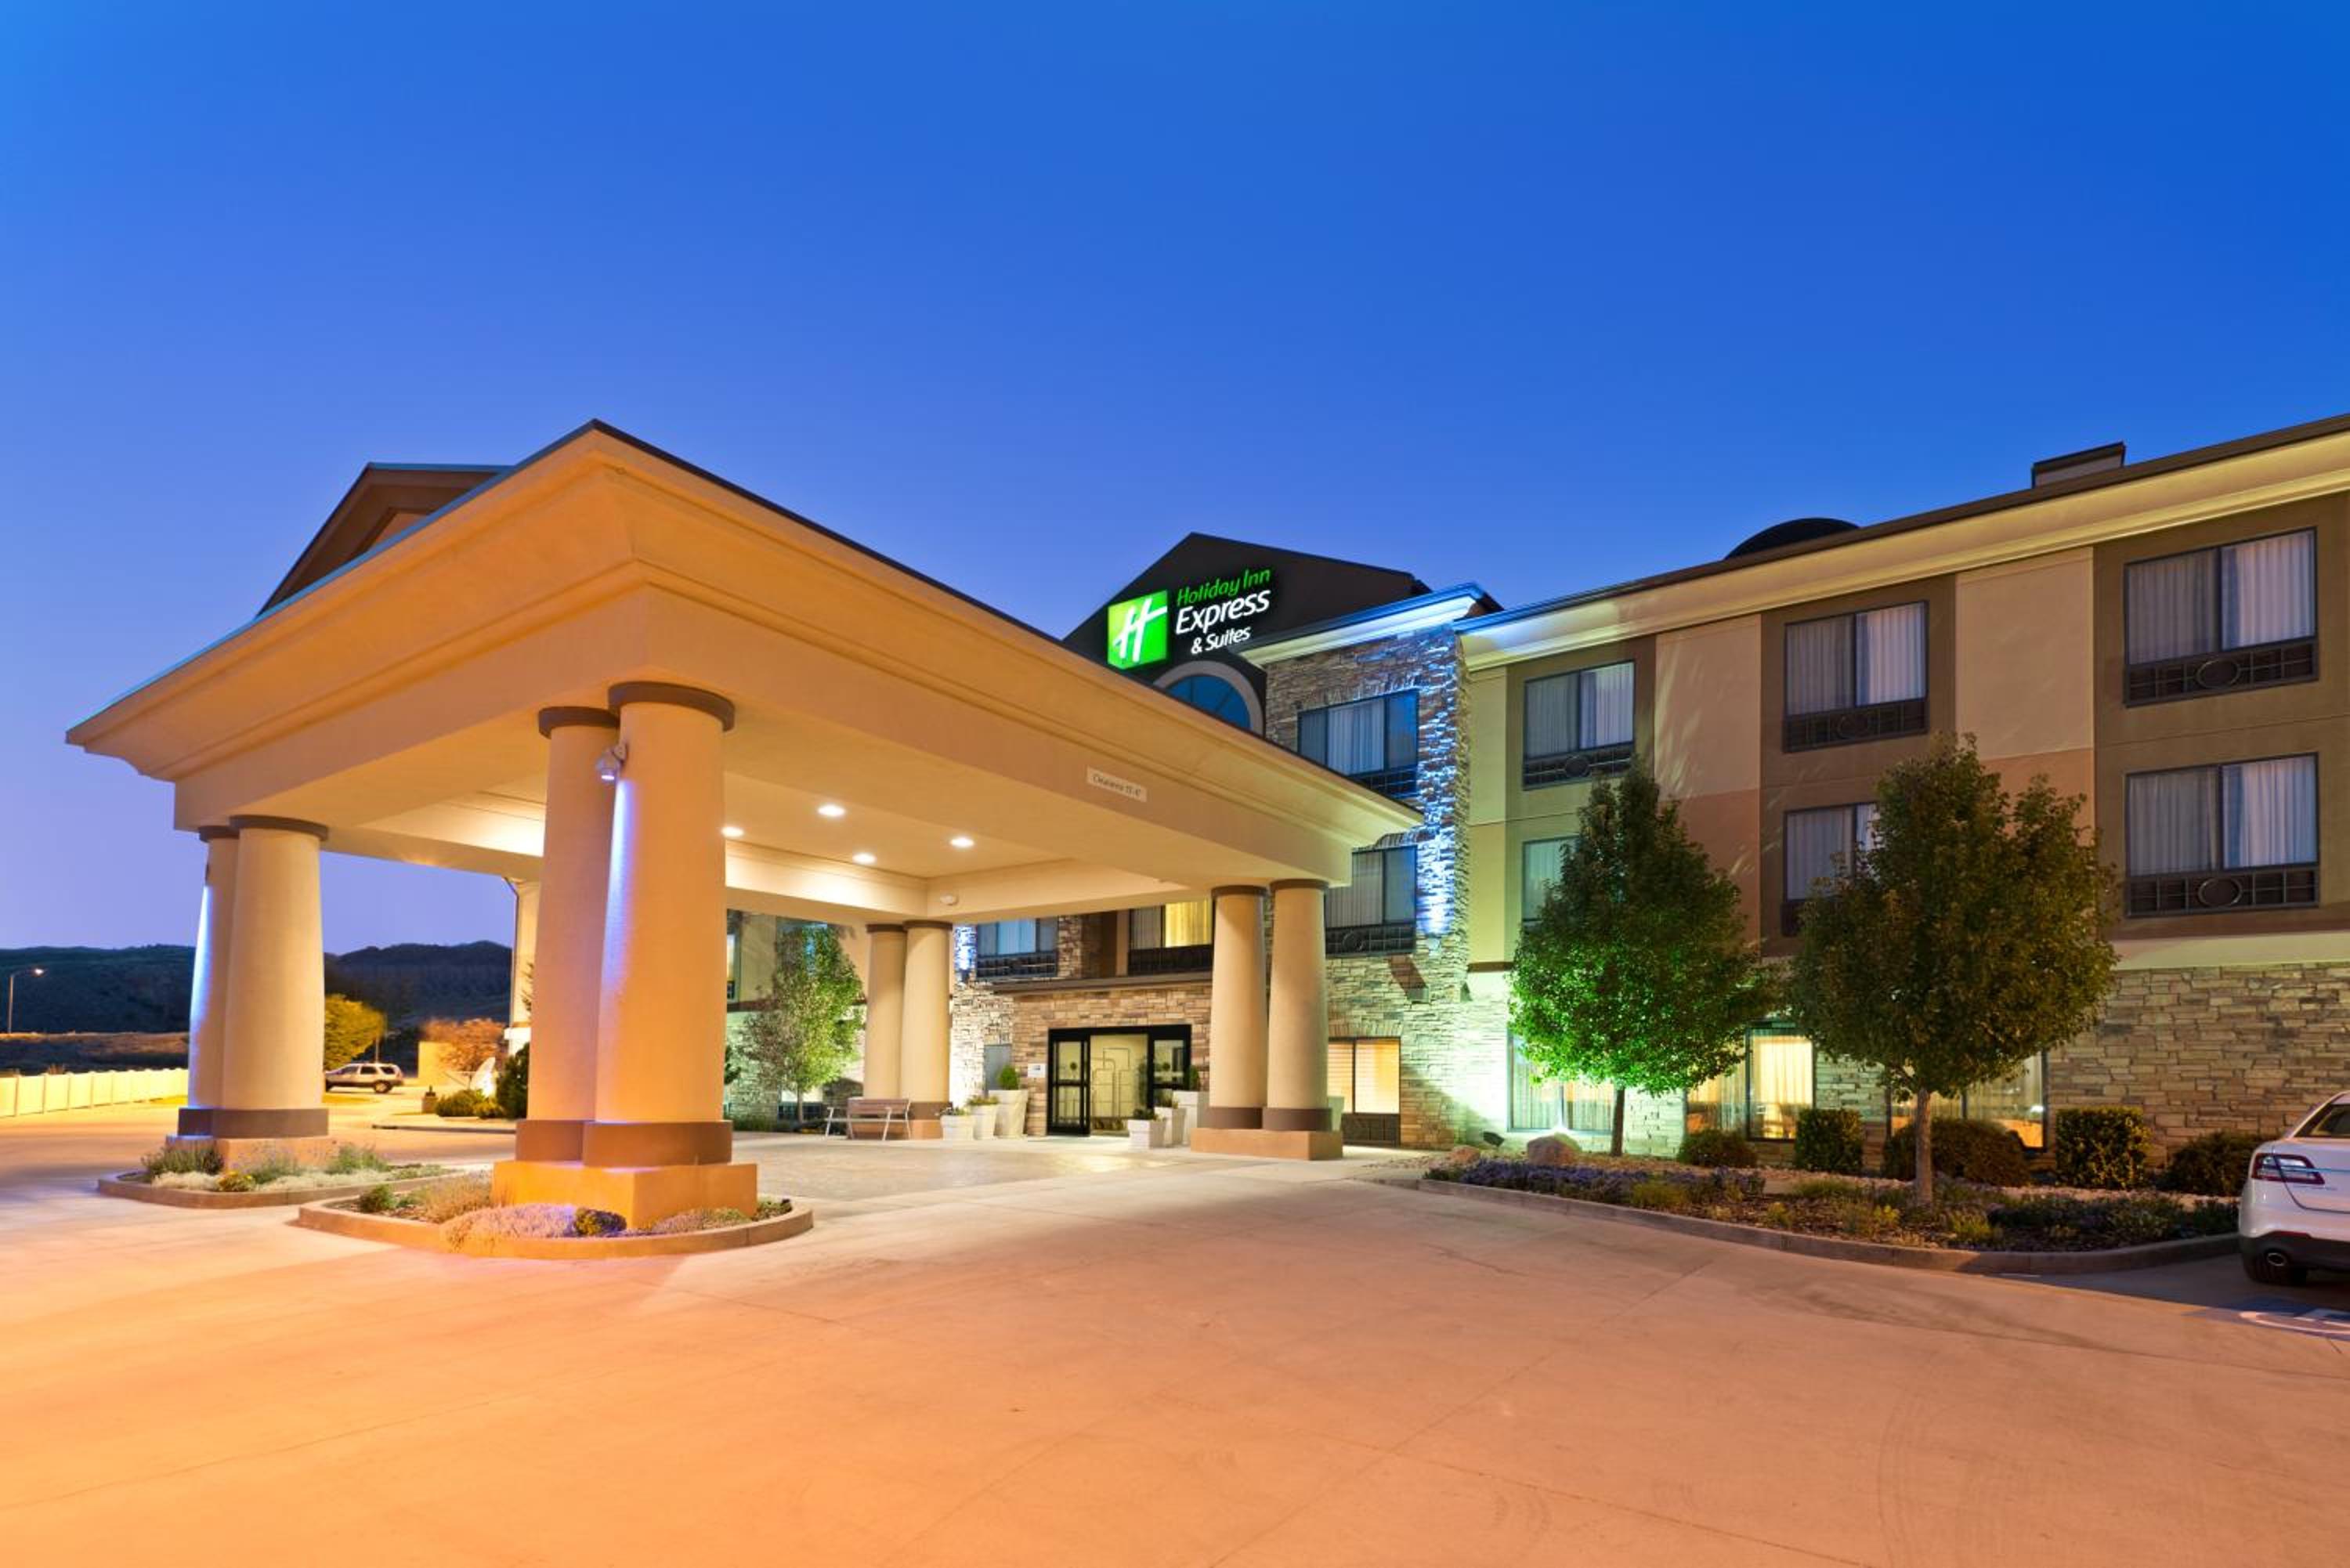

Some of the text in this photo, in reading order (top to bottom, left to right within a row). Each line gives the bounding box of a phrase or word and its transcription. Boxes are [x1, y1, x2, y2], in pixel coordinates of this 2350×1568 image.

[1177, 569, 1271, 606] Holiday Inn
[1176, 590, 1271, 634] Express
[1191, 627, 1251, 654] & Suites
